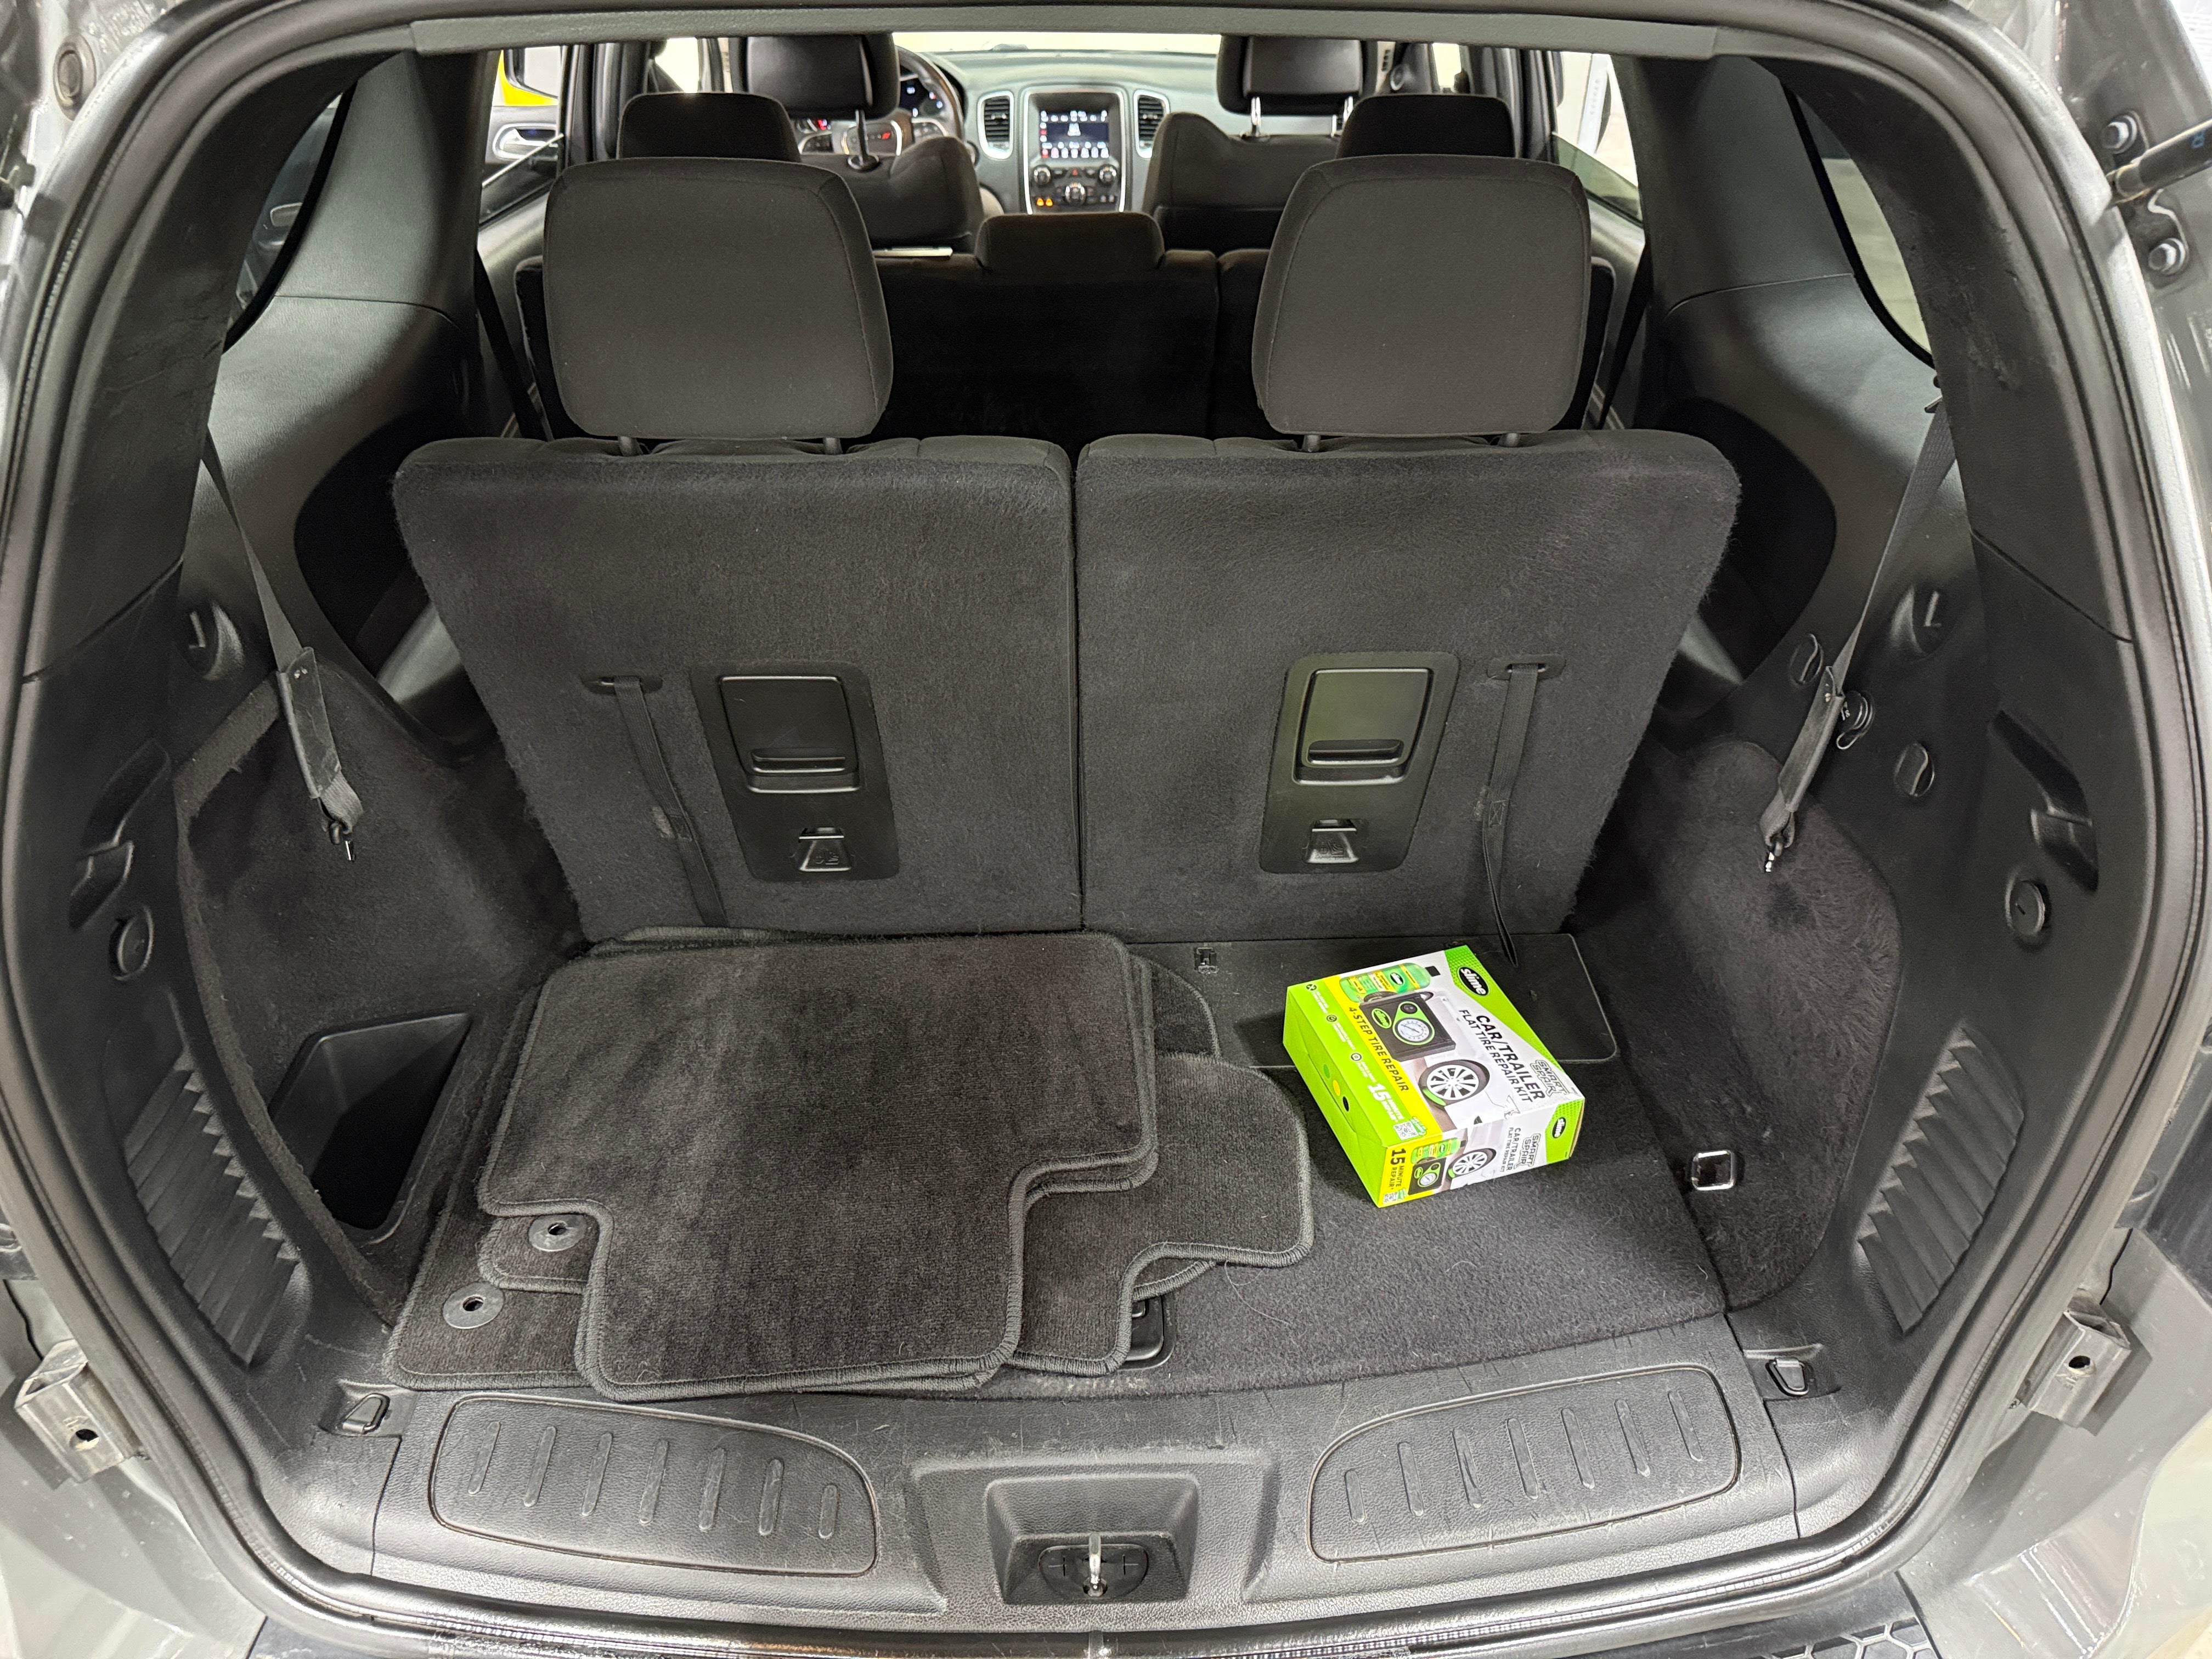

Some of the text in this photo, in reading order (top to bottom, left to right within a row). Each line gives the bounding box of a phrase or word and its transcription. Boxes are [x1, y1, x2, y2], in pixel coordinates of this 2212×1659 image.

[1460, 968, 1487, 995] slime
[1374, 1009, 1390, 1027] slime
[1348, 1007, 1373, 1035] 4-STEP
[1368, 1037, 1388, 1057] TIRE
[1381, 1058, 1409, 1091] REPAIR
[1459, 1009, 1533, 1102] FLAT TIRE REPAIR KIT
[1476, 1015, 1545, 1099] CAR/TRAILER
[1532, 1064, 1557, 1093] SPAIR
[1537, 1060, 1568, 1093] SMART
[1367, 1083, 1392, 1101] 15
[1390, 1148, 1407, 1165] 15
[1506, 1127, 1521, 1170] CAR/TRAILER
[1519, 1139, 1531, 1165] SPAIR
[1527, 1134, 1539, 1165] SMART
[1395, 1165, 1405, 1187] MINUTE
